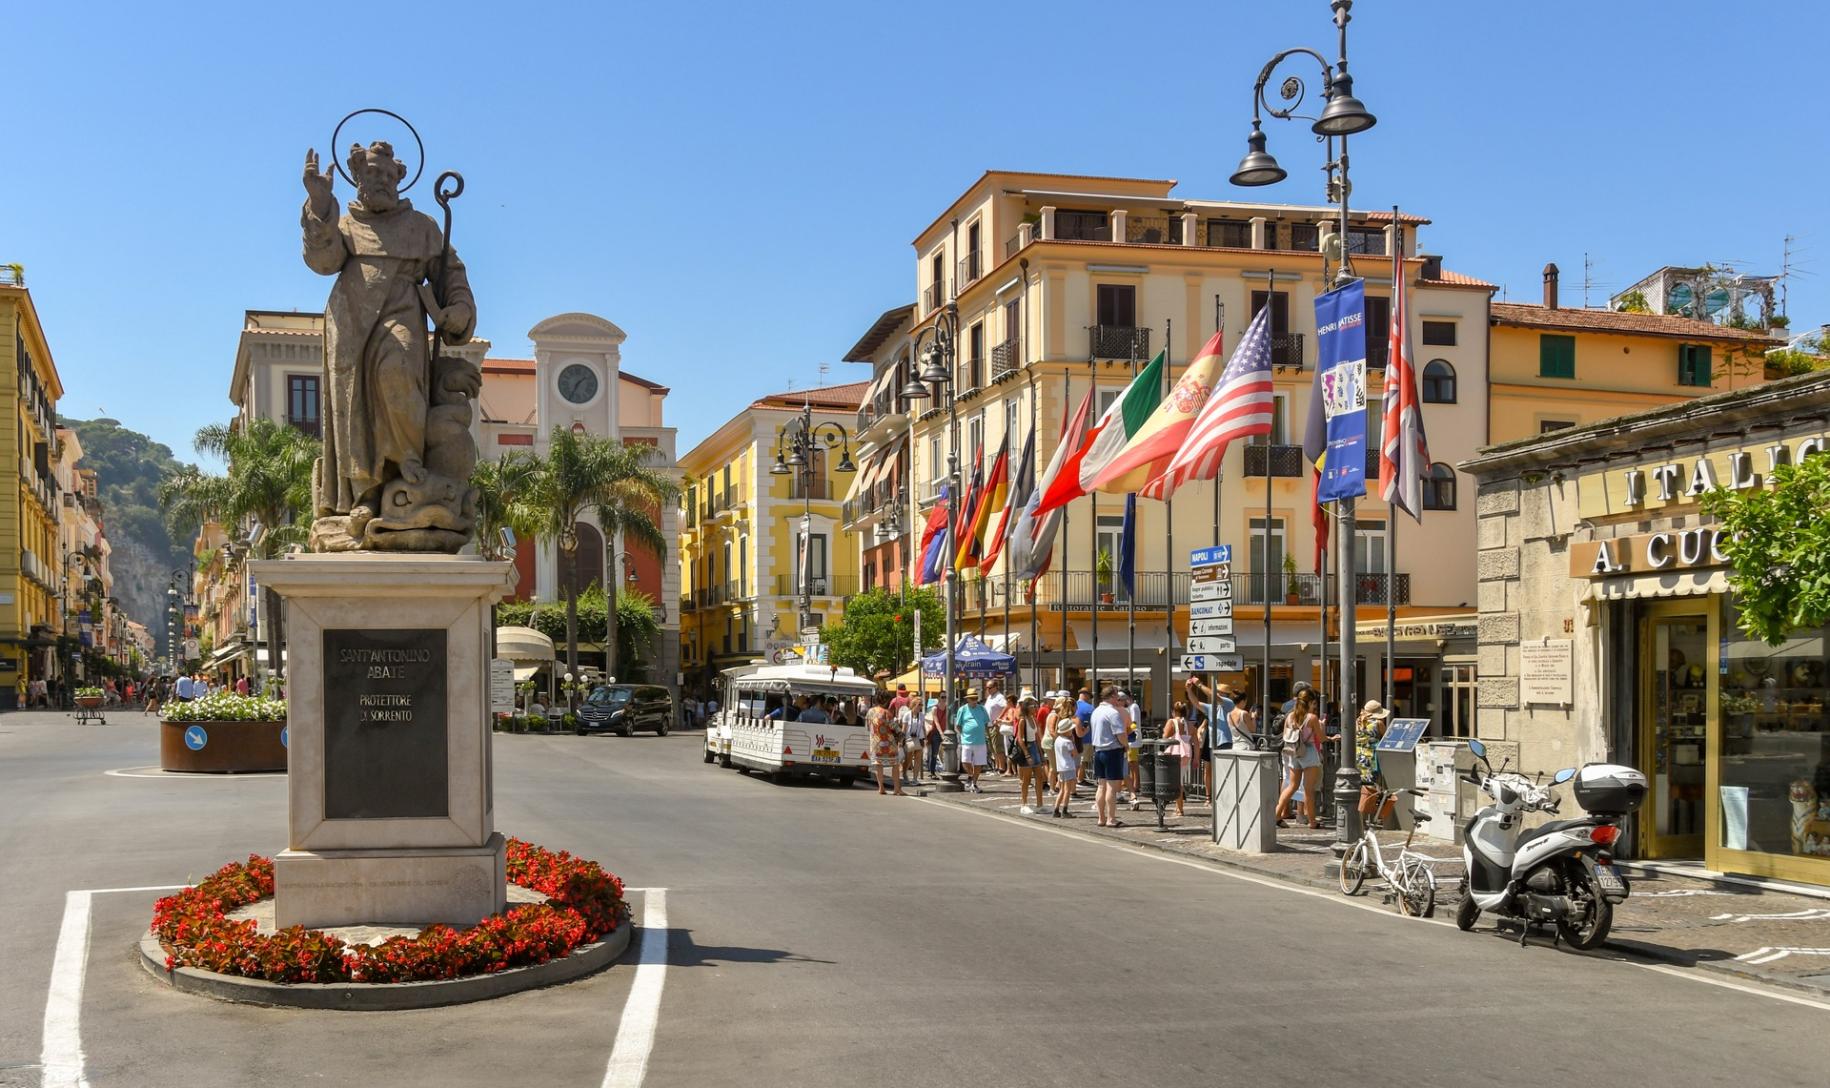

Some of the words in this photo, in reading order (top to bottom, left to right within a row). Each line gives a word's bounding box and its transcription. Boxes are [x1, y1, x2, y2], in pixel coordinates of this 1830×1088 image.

[1317, 322, 1337, 336] HENRI
[1192, 551, 1208, 562] NAPOLI
[1592, 541, 1623, 573] A.
[1220, 642, 1231, 650] porto
[340, 649, 430, 662] SANT'ANTONINO
[367, 665, 406, 679] ABATE
[360, 694, 412, 706] PROTETTORE
[370, 710, 412, 721] SORRENTO
